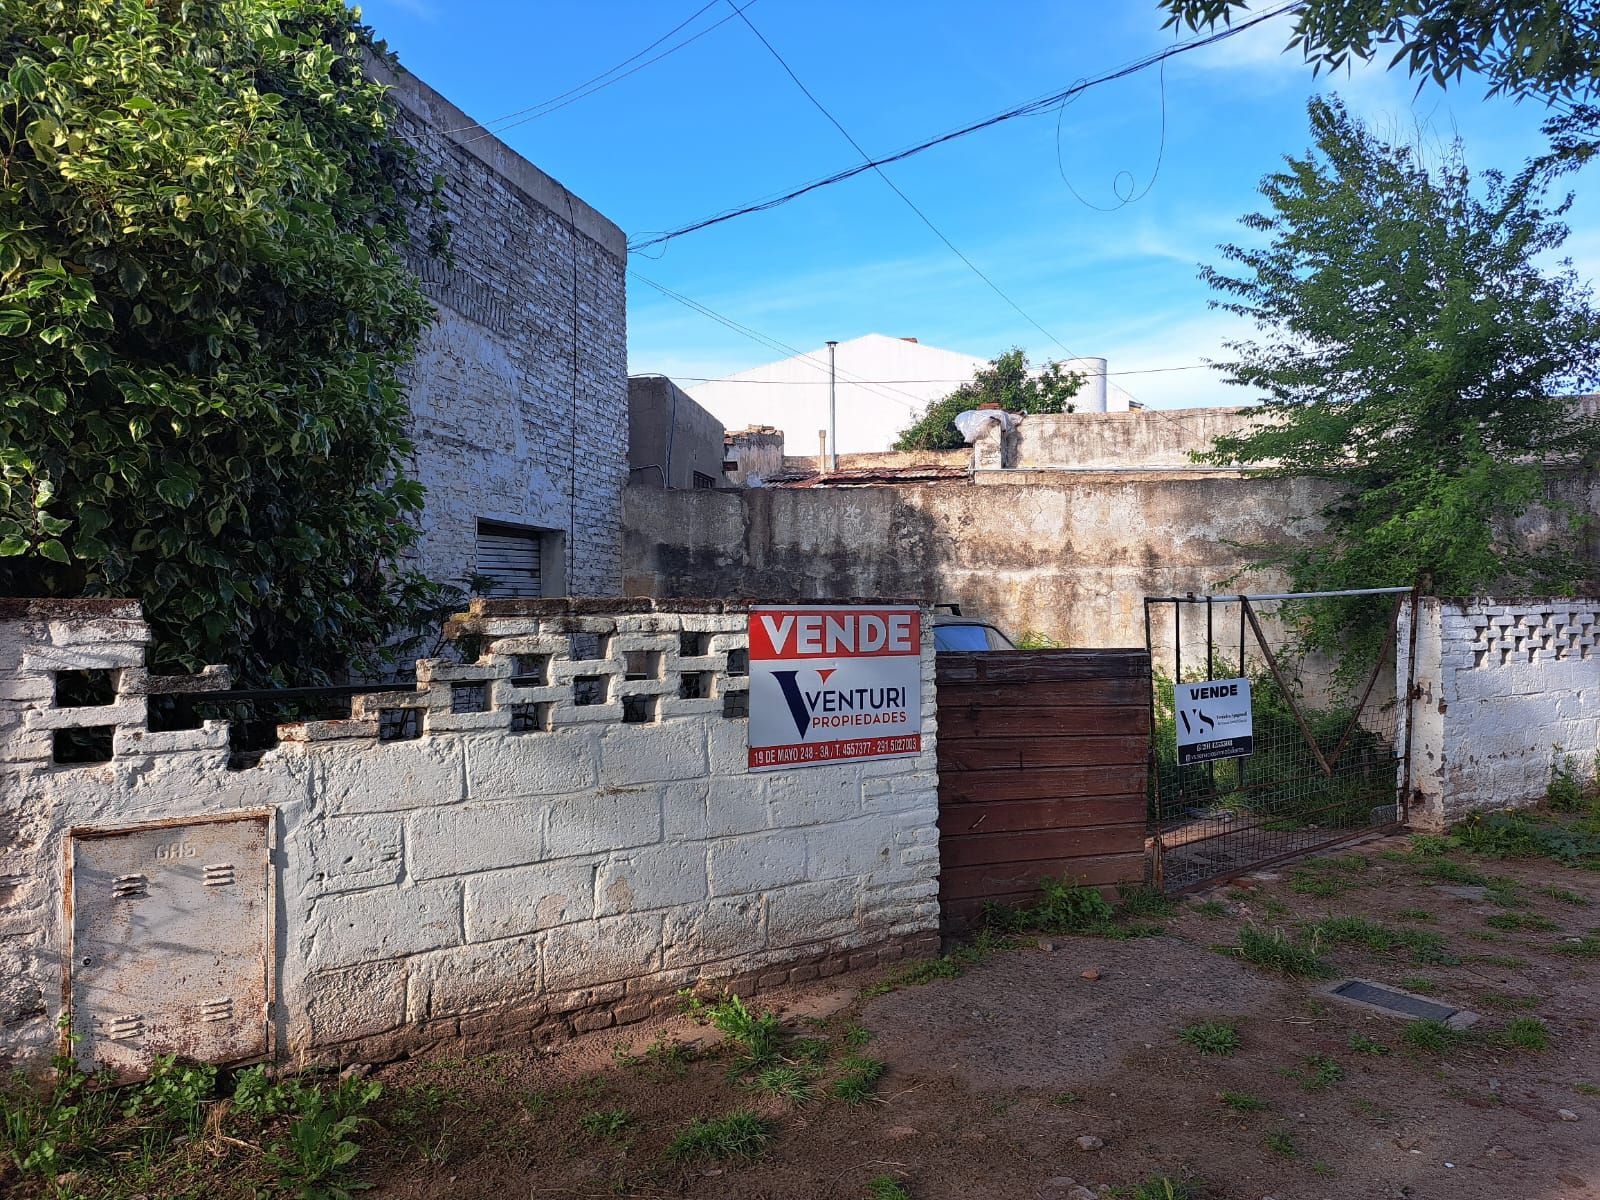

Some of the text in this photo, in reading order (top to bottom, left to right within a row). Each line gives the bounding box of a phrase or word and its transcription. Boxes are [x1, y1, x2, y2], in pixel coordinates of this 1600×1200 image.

[760, 614, 912, 655] VENDE
[805, 687, 906, 712] VENTURI
[1190, 684, 1238, 701] VENDE
[812, 711, 907, 728] PROPIEDADES
[765, 750, 776, 763] DE
[777, 748, 799, 762] MAYO
[800, 747, 814, 760] 248
[819, 745, 829, 758] 3A
[155, 842, 196, 859] GAS
